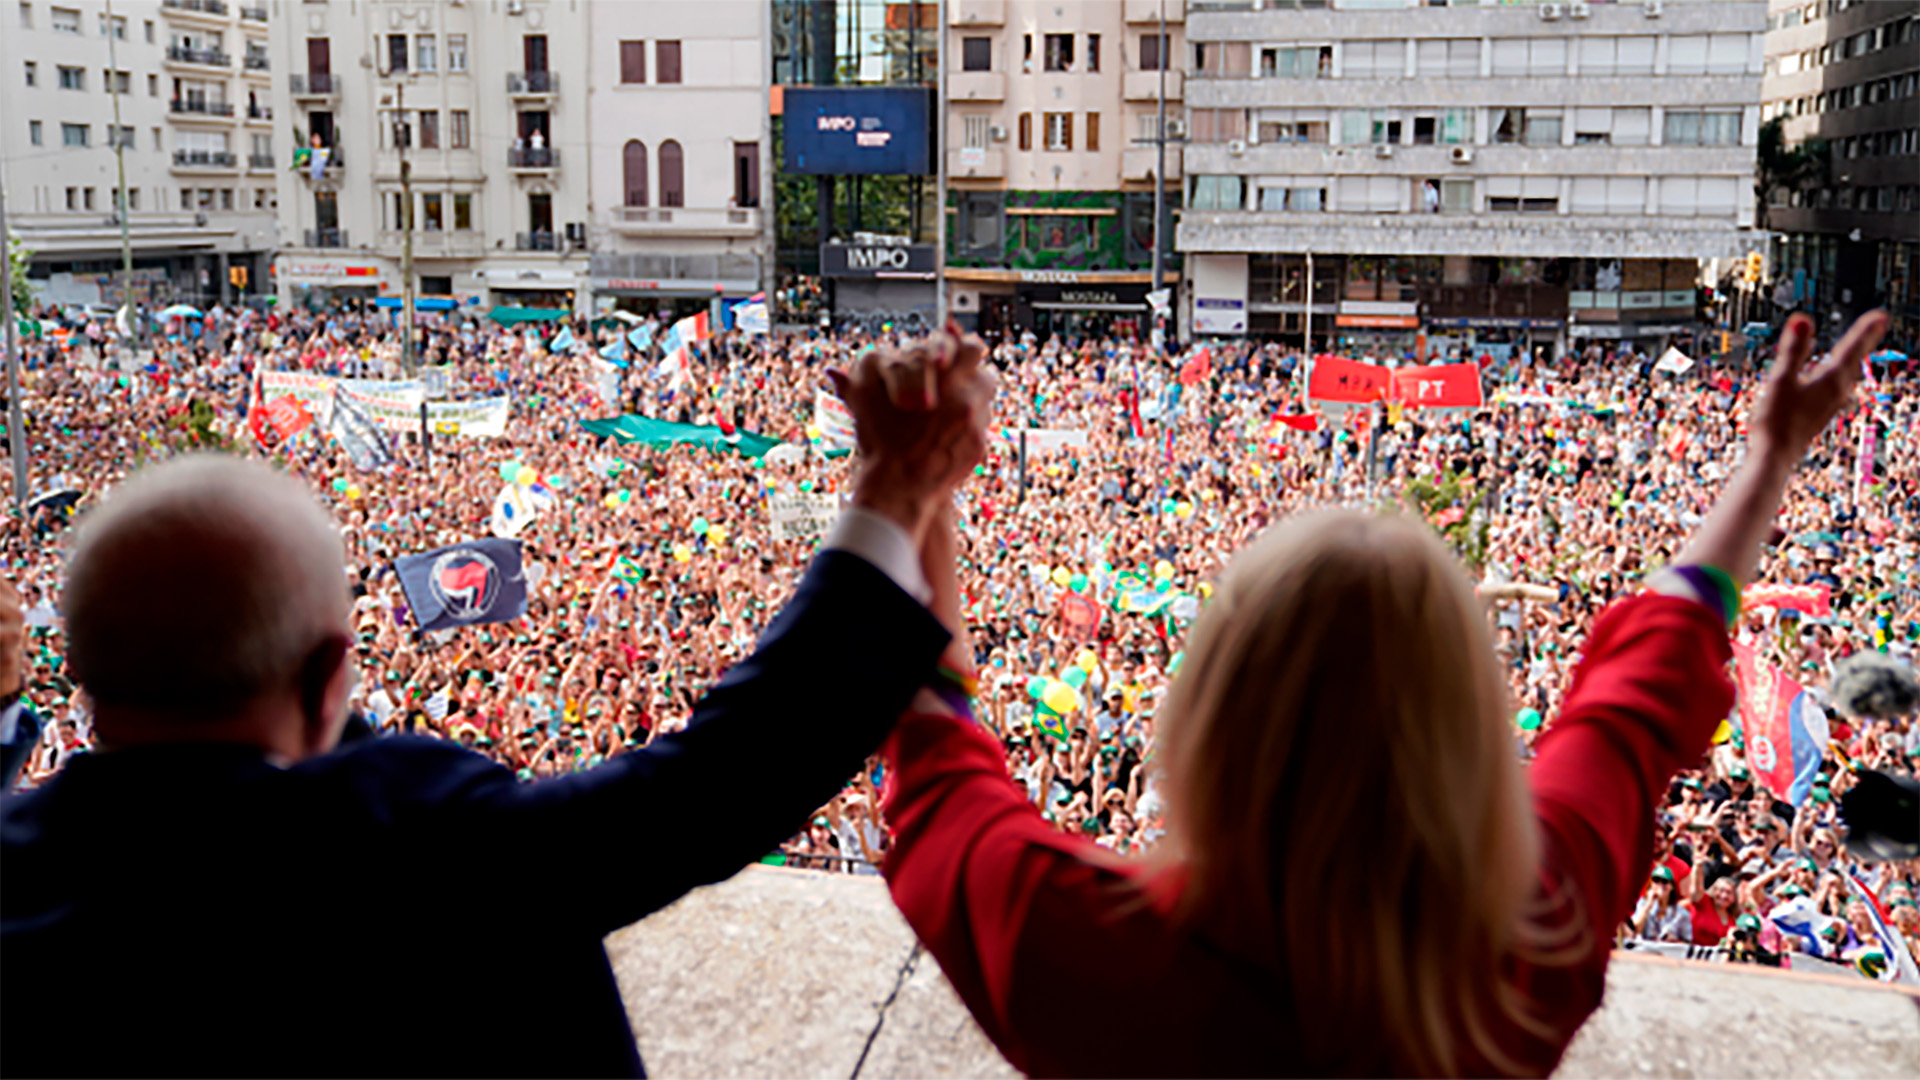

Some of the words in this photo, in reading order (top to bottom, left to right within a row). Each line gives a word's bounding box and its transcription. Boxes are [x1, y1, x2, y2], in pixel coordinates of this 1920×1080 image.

[817, 116, 856, 131] IMPO
[847, 247, 909, 270] IMPO
[1061, 291, 1117, 302] MOSTAZA
[1418, 380, 1446, 399] PT
